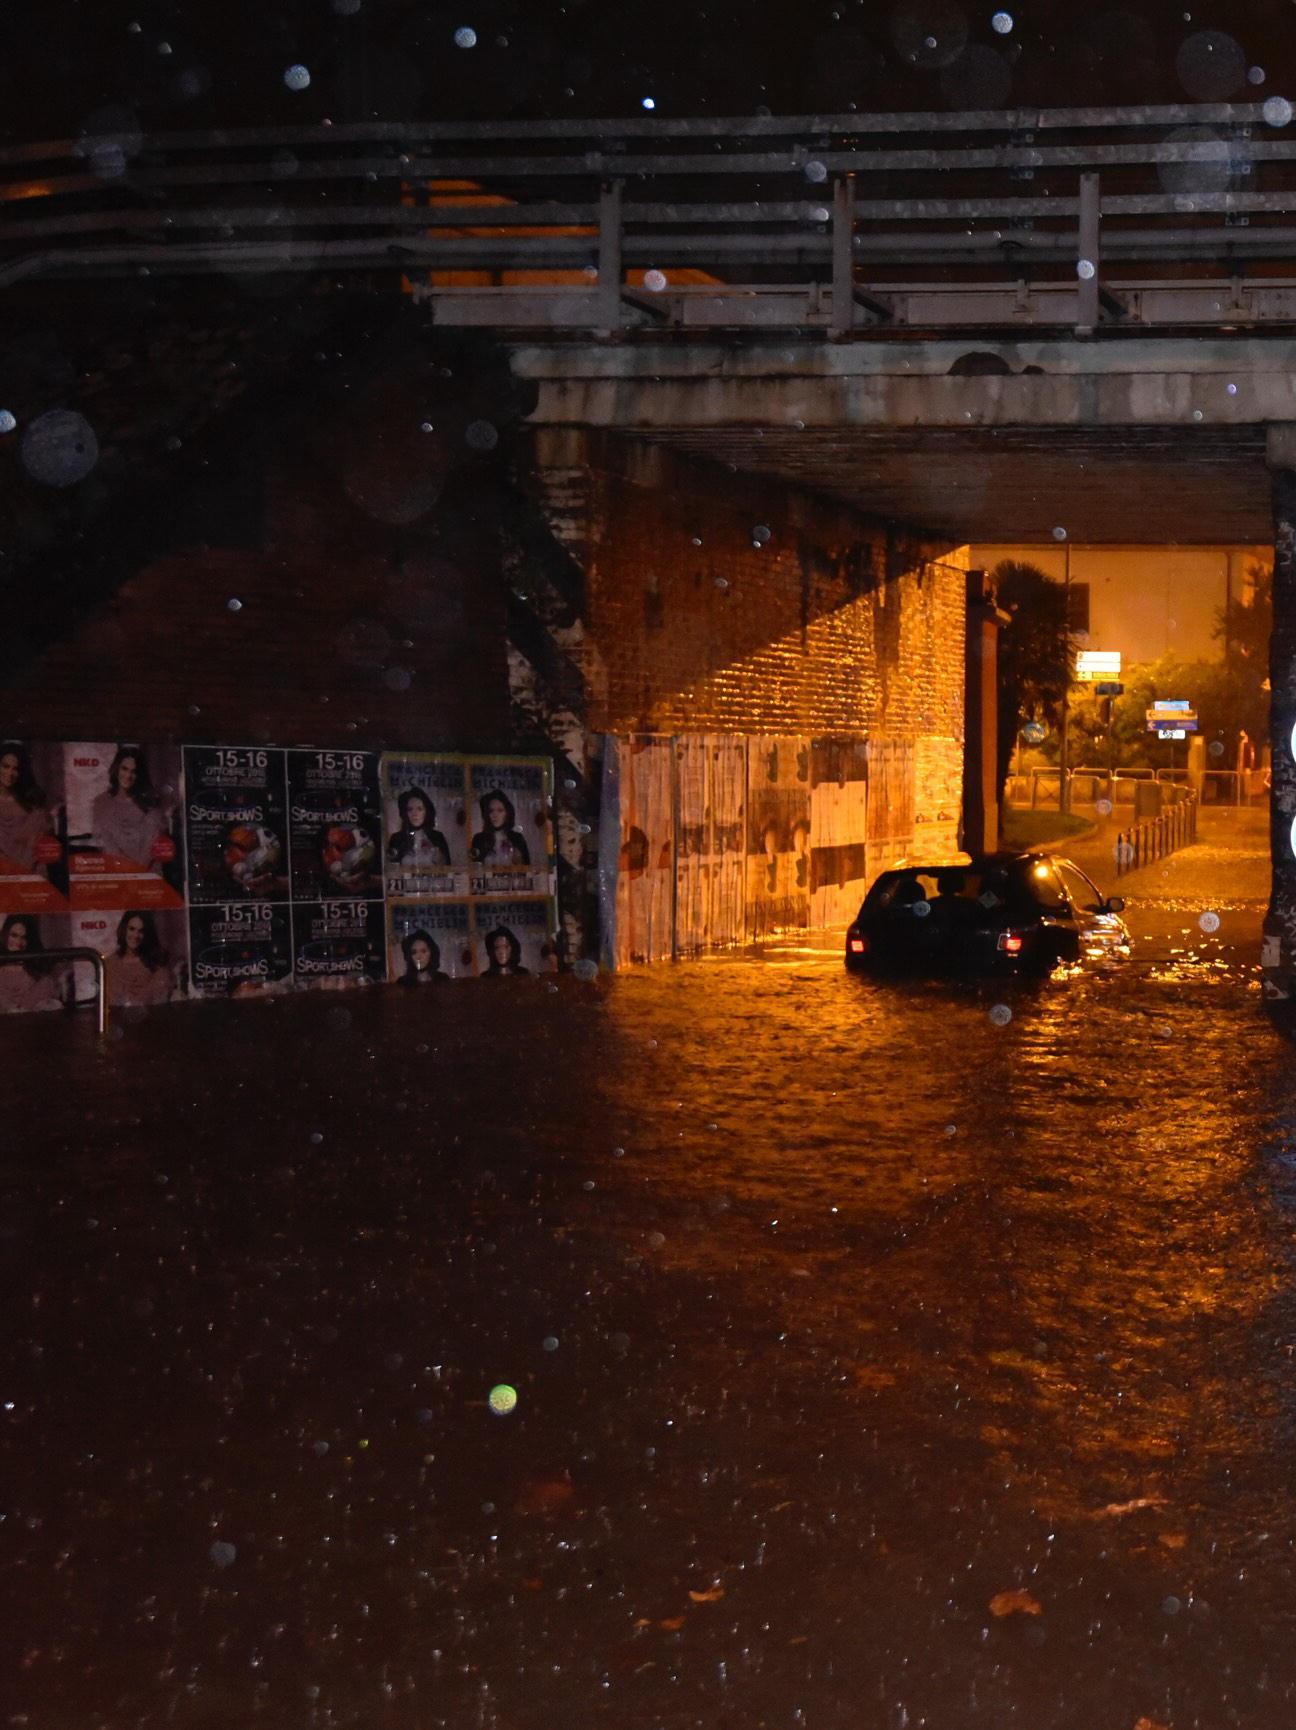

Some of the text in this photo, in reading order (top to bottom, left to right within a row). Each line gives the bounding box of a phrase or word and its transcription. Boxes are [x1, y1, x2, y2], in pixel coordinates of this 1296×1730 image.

[215, 750, 268, 768] 15-16
[315, 752, 364, 770] 15-16
[221, 904, 273, 922] 15-16
[320, 902, 368, 919] 15-16
